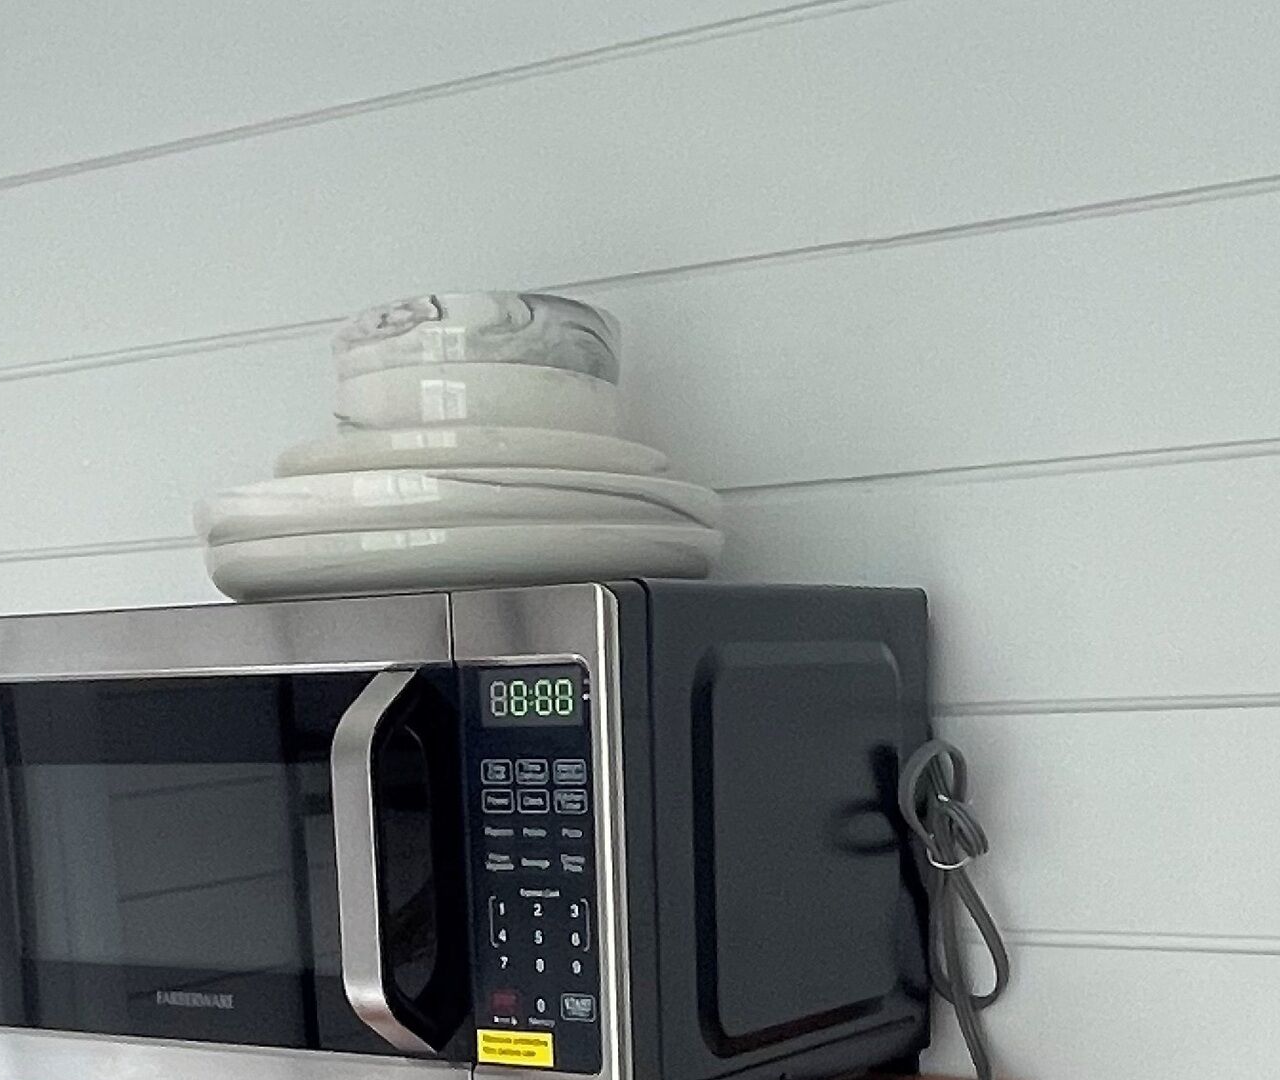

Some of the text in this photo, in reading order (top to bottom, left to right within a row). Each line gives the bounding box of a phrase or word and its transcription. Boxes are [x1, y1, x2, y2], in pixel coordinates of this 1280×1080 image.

[498, 901, 580, 918] 1 2 3
[498, 928, 507, 943] 4
[534, 929, 543, 945] 5
[536, 998, 546, 1013] 0
